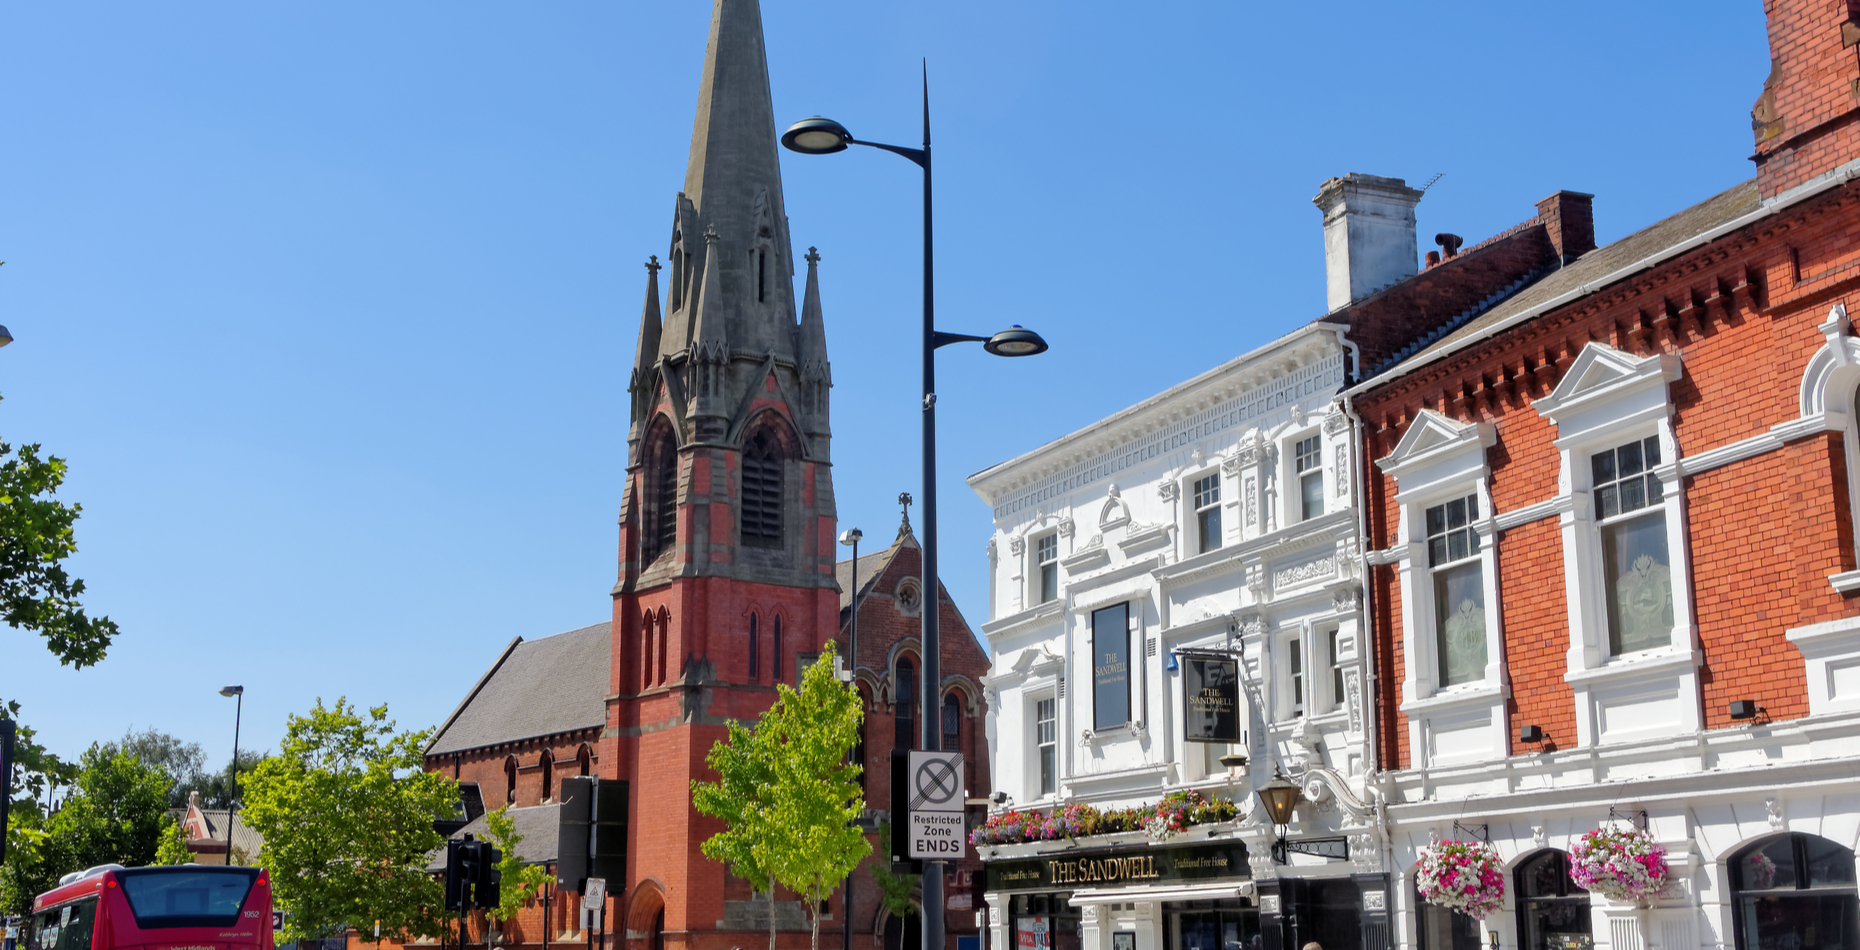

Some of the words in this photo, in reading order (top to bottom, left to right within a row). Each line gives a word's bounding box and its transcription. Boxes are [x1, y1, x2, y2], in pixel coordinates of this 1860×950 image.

[1105, 653, 1117, 664] THE
[1095, 662, 1127, 677] SANDWELL
[1203, 687, 1220, 696] THE
[1190, 695, 1234, 706] SANDWELL
[914, 815, 961, 824] Restricted
[924, 825, 951, 836] Zone
[916, 839, 960, 852] ENDS
[1174, 857, 1200, 869] Traditional
[1200, 856, 1211, 867] Free
[1212, 856, 1228, 867] House
[1049, 860, 1077, 884] THE
[1079, 856, 1159, 882] SANDWELL
